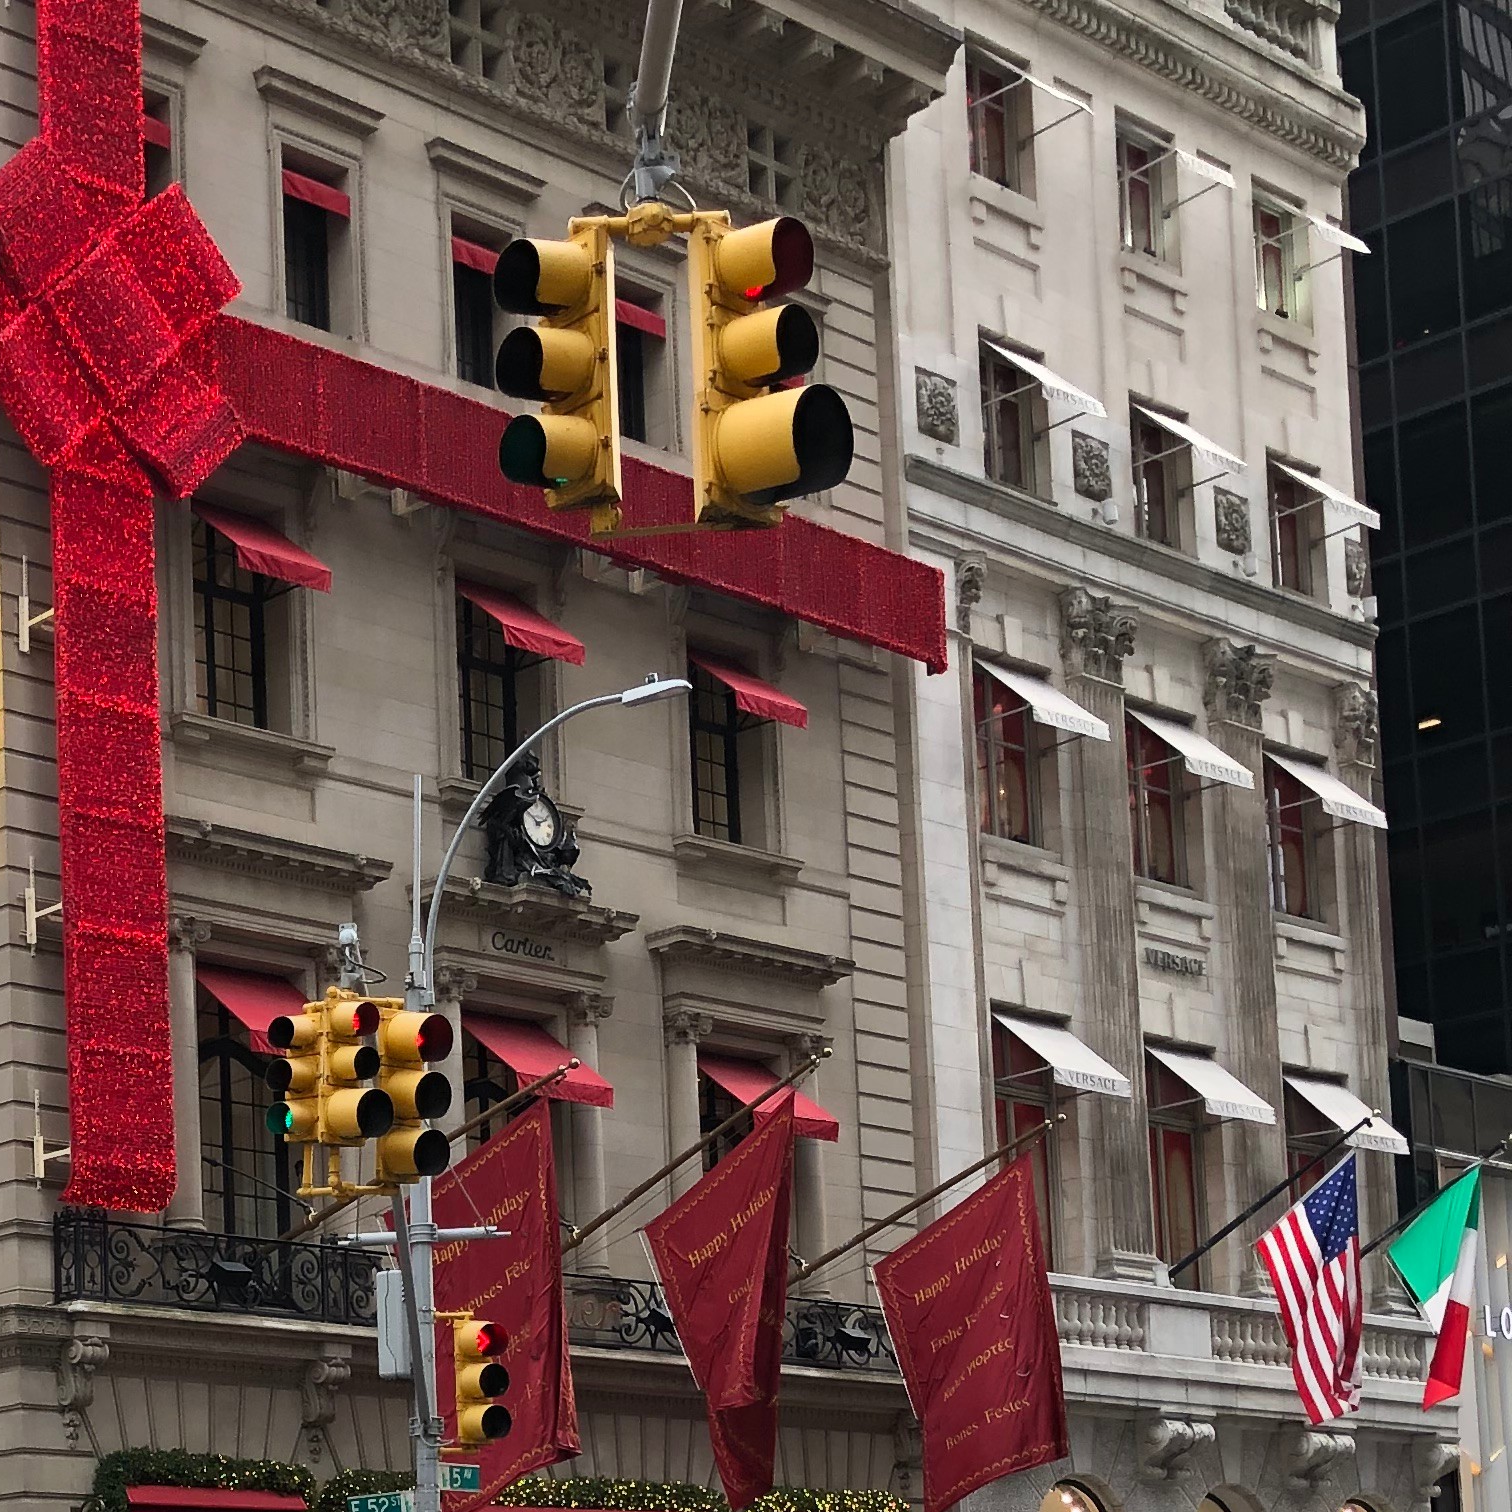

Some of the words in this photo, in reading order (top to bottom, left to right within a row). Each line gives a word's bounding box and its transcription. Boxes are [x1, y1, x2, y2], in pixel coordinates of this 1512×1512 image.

[491, 931, 555, 961] Cartier
[1145, 946, 1208, 977] VERSACE
[1068, 1070, 1118, 1092] VERSACE
[688, 1230, 729, 1269] Happy
[914, 1269, 951, 1306] Happy
[945, 1420, 979, 1450] Bones
[452, 1468, 462, 1488] 5
[391, 1495, 402, 1507] ST
